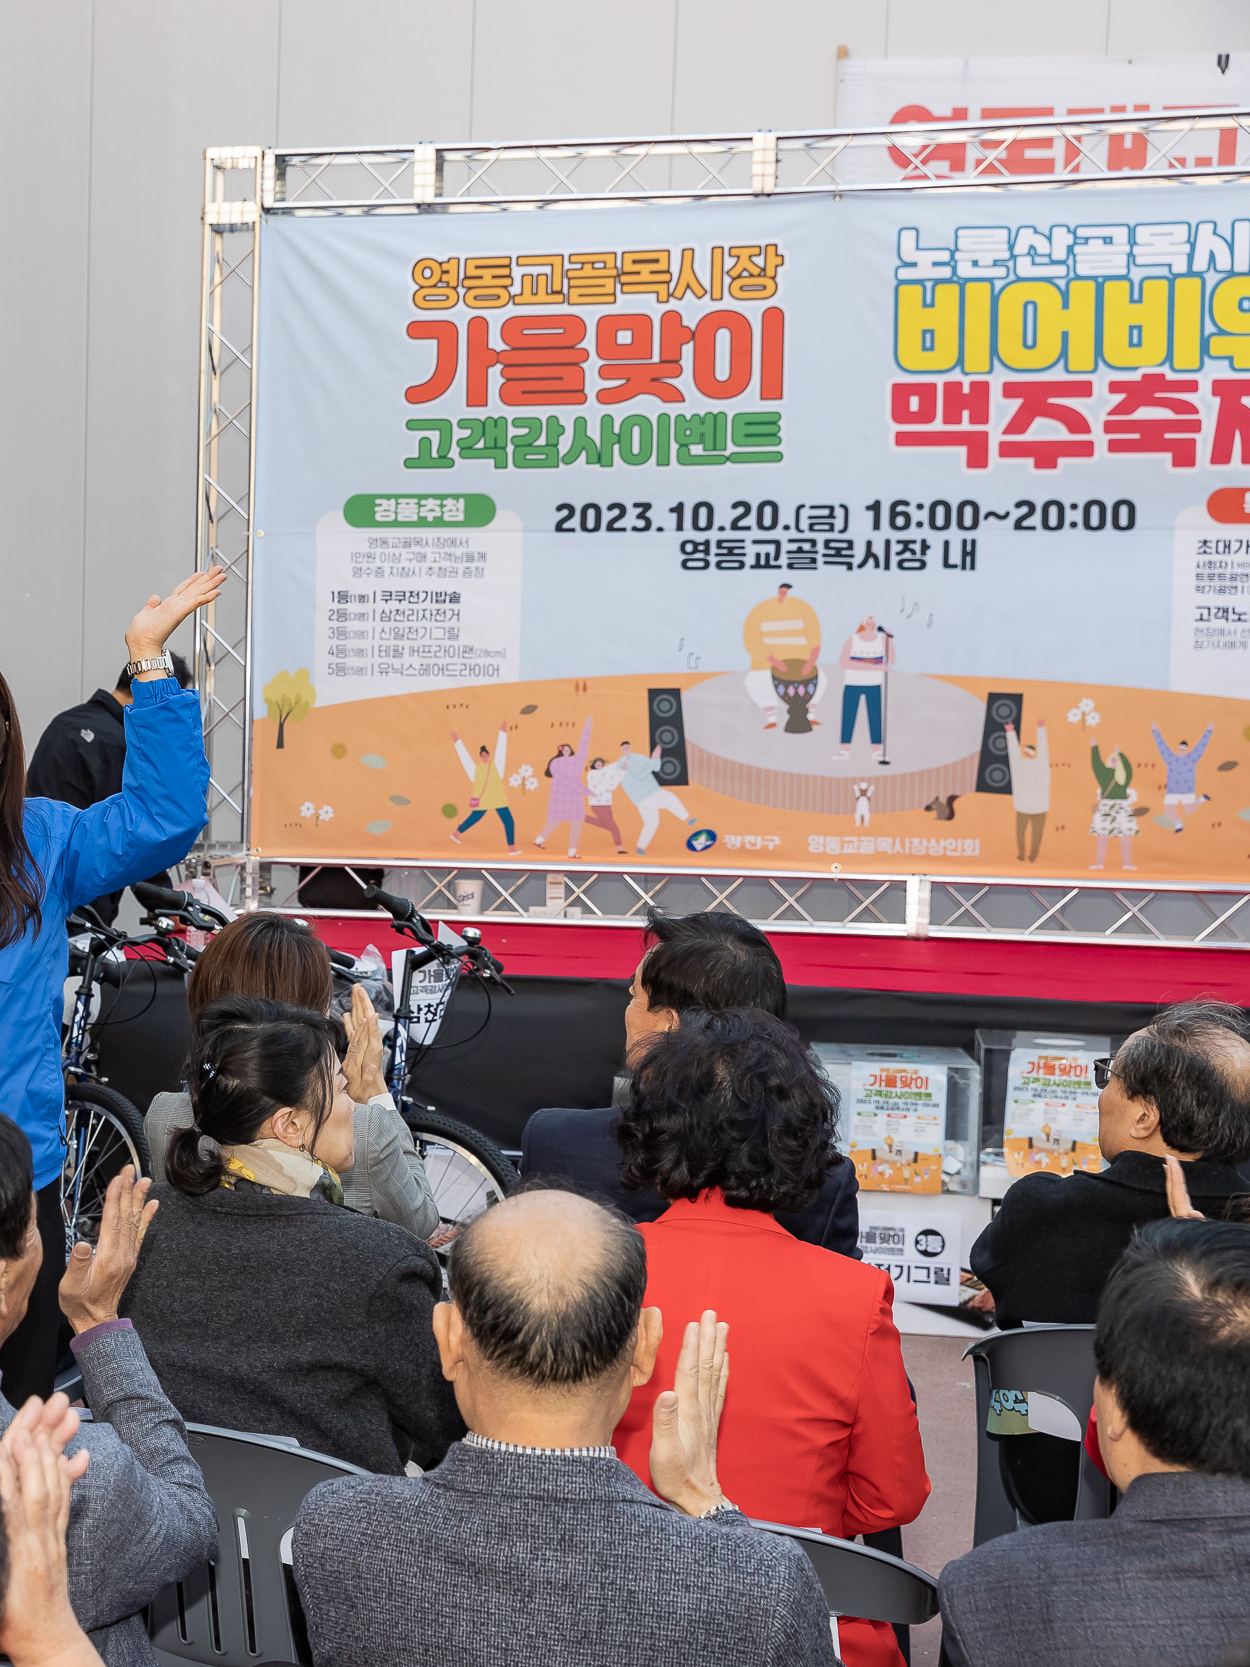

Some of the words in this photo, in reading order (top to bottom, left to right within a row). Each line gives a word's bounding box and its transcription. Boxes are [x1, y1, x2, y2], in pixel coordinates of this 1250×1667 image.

[411, 243, 784, 310] 영동교골목시장
[404, 306, 785, 407] 가을맞이
[403, 411, 784, 469] 고객감사이벤트
[374, 497, 466, 522] 경품추첨
[554, 500, 849, 533] 2023.10.20.(금)
[864, 498, 1137, 532] 16:00~20:00
[379, 551, 402, 564] 이상
[679, 538, 931, 571] 영동교골목시장
[942, 538, 977, 571] 내
[380, 590, 462, 604] 쿠쿠전기밥솥
[379, 608, 461, 622] 삼천리자전거
[379, 626, 461, 641] 신일전기그릴
[377, 662, 500, 678] 유닉스헤어드라이어
[722, 833, 781, 850] 광진구
[806, 834, 981, 857] 영동교골목시장상인회
